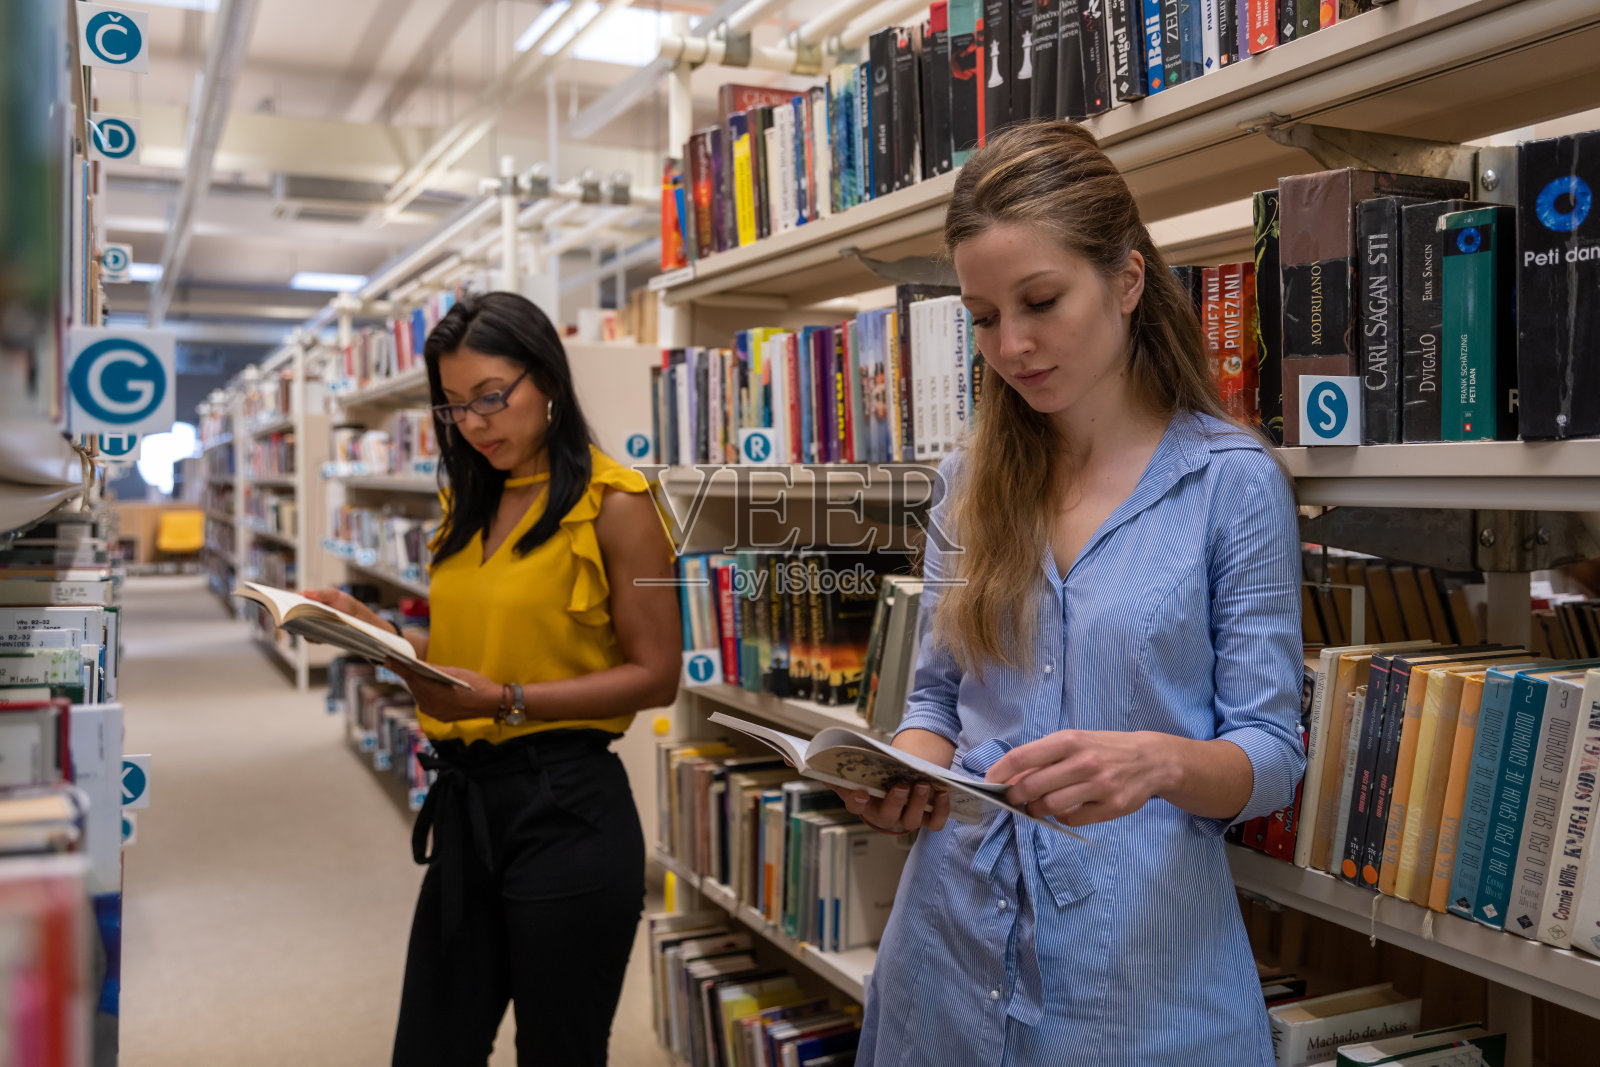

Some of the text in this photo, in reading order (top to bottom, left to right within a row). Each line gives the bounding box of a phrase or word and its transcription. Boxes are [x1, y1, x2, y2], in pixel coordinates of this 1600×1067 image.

[95, 14, 128, 61] Č
[1114, 27, 1130, 76] Angel
[1146, 14, 1162, 69] Beli
[102, 123, 129, 153] D
[1423, 244, 1433, 301] ERIK SANCIN
[1524, 245, 1600, 267] Peti dan
[1224, 273, 1240, 349] POVEZANI
[1365, 276, 1388, 337] SAGAN
[955, 308, 967, 421] dolgo iskanje
[1365, 340, 1388, 391] CARL
[1420, 334, 1436, 392] DVIGALO
[88, 350, 155, 413] G
[1318, 387, 1337, 431] S
[633, 439, 646, 457] P
[751, 434, 765, 460] R
[697, 659, 709, 681] T
[1479, 708, 1504, 761] GOVORIMO
[1509, 711, 1535, 767] GOVORIMO
[1543, 717, 1571, 774] GOVORIMO
[1476, 765, 1495, 780] NE
[1505, 768, 1525, 785] NE
[1540, 776, 1561, 793] NE
[1574, 736, 1600, 803] SODNEGA
[1471, 781, 1492, 816] SPLOH
[1499, 786, 1522, 822] SPLOH
[1533, 794, 1558, 831] SPLOH
[1388, 803, 1405, 842] WELLS
[1439, 816, 1459, 858] WELLS
[1467, 818, 1486, 841] PSU
[1495, 822, 1515, 846] PSU
[1563, 805, 1591, 859] KNJIGA
[1528, 831, 1550, 855] PSU
[1462, 853, 1479, 870] DA
[1489, 859, 1507, 876] DA
[1523, 868, 1543, 886] DA
[1558, 863, 1578, 889] Willis
[1552, 889, 1574, 921] Connie
[1306, 1021, 1408, 1051] Machado de Assis
